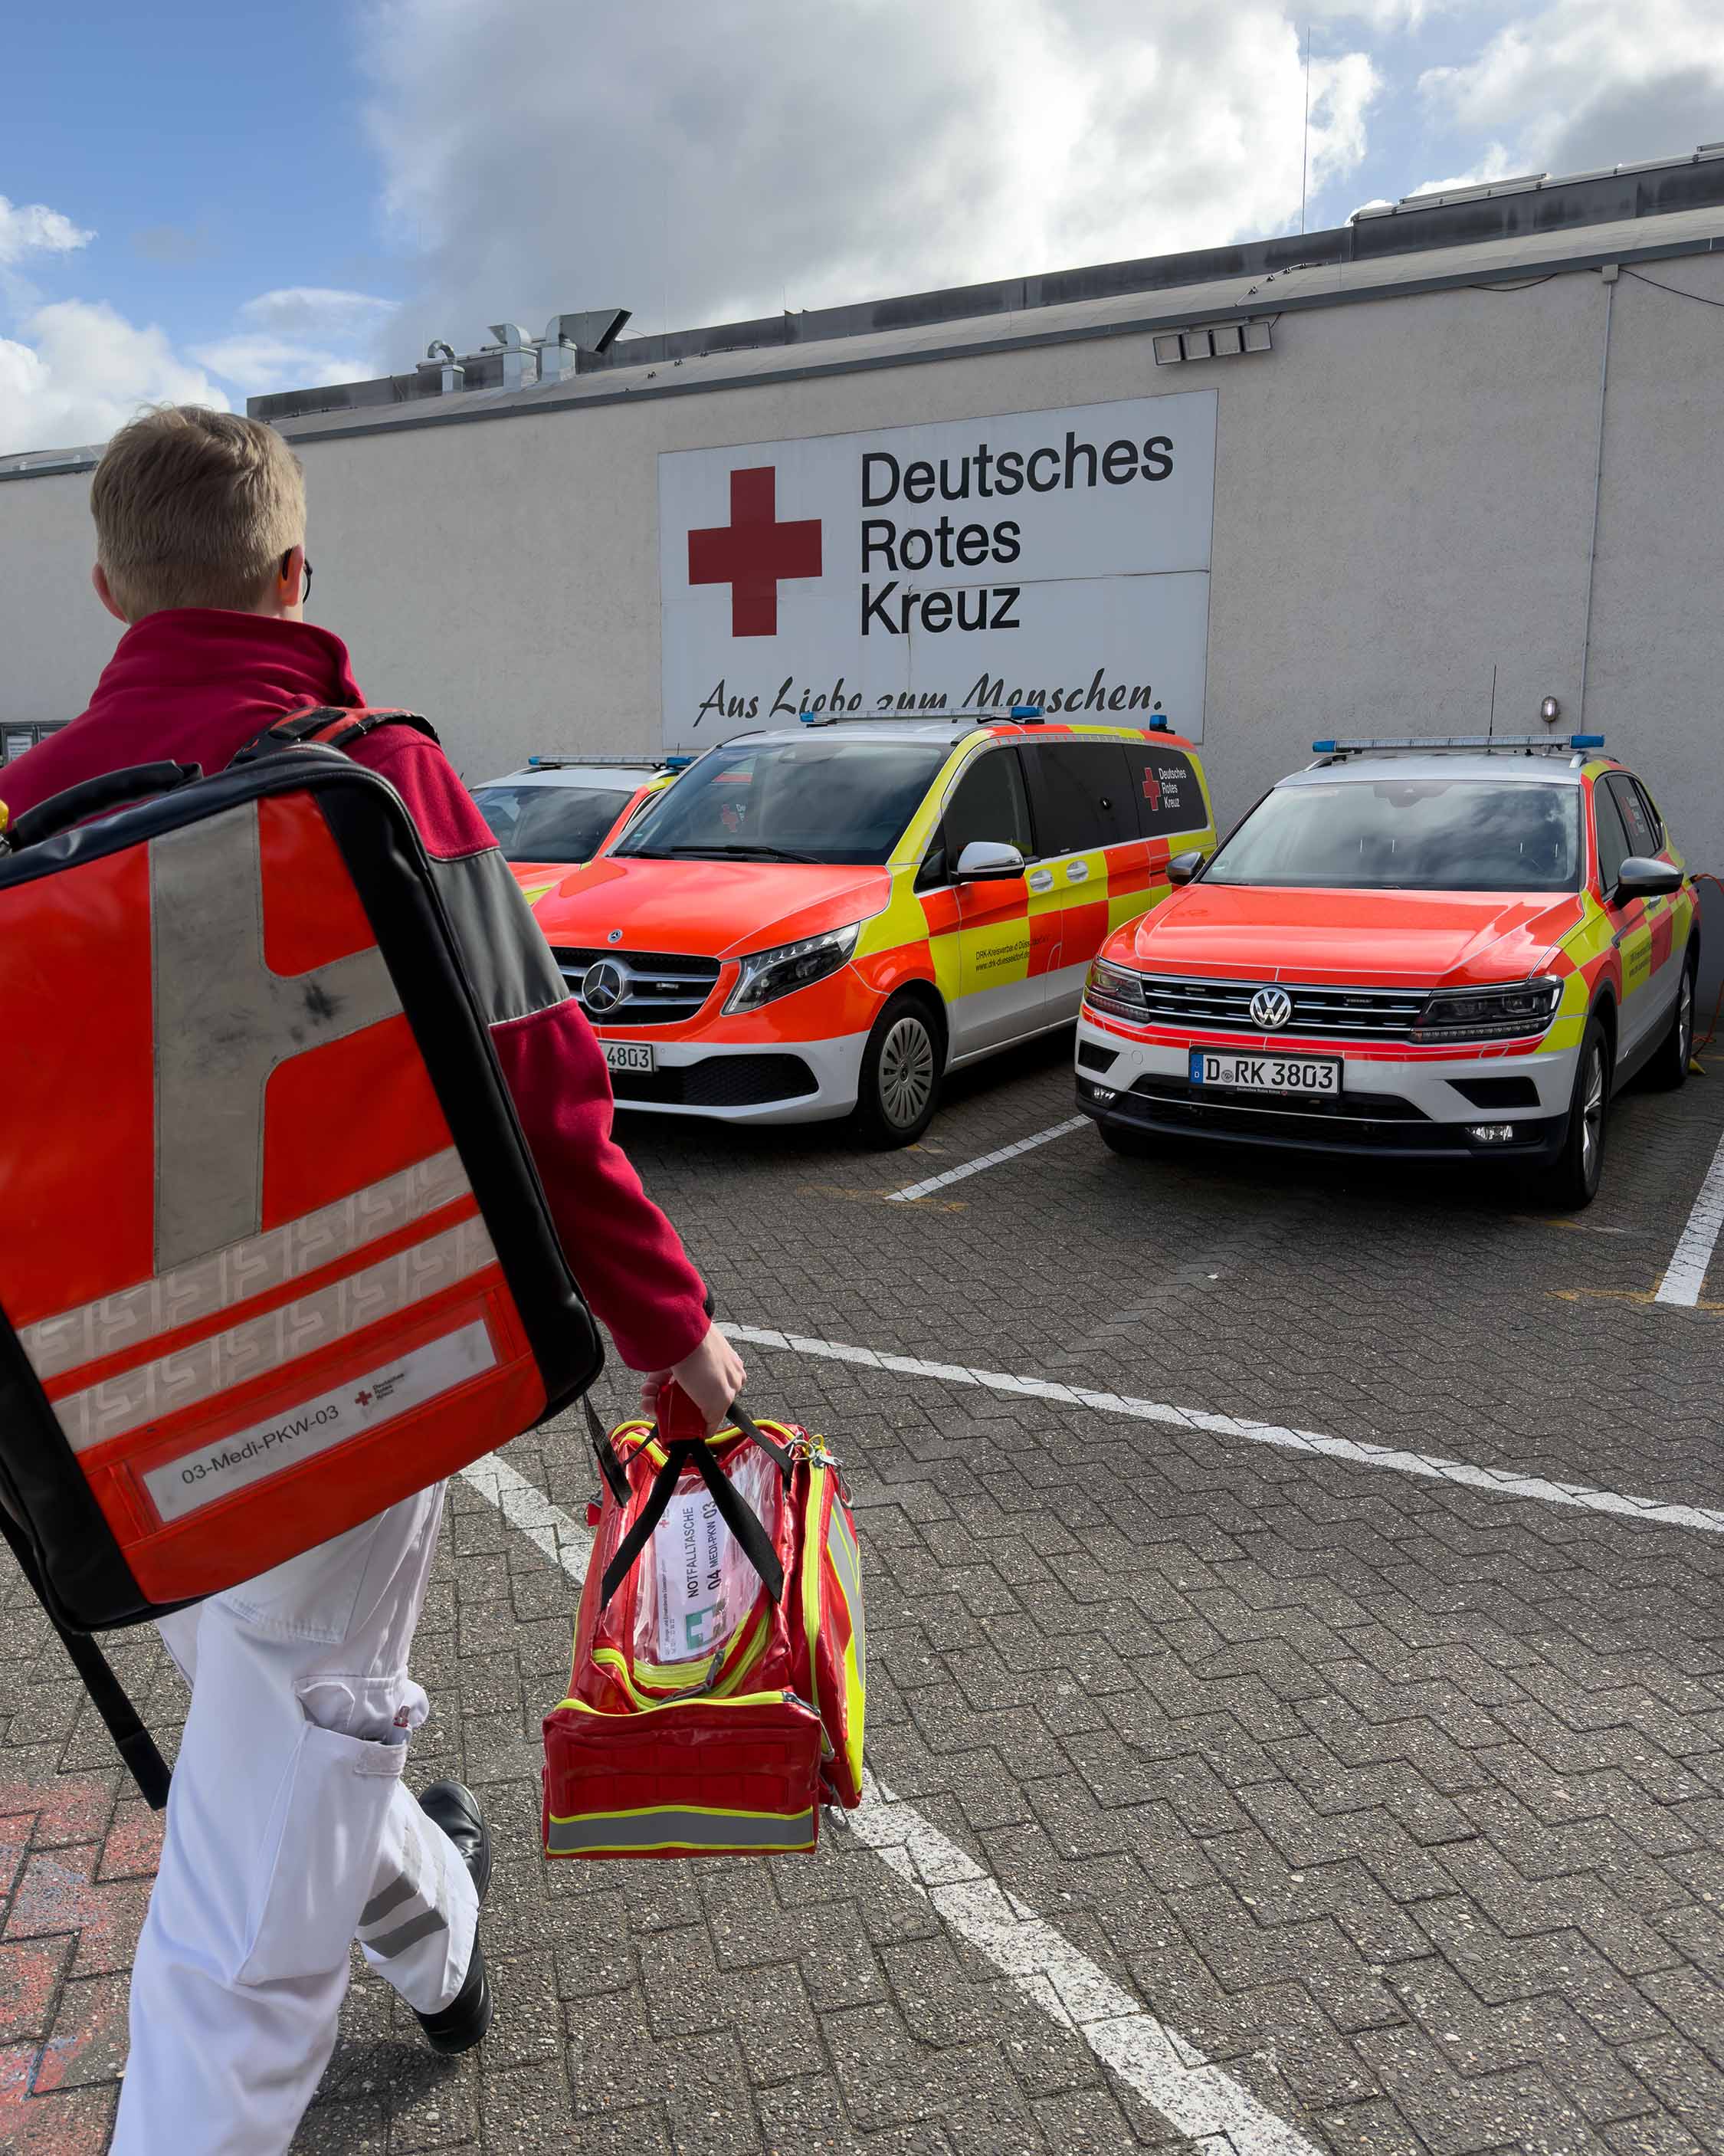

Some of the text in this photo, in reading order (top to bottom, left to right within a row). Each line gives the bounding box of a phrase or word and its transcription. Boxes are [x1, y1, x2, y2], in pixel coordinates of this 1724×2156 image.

[861, 432, 1174, 508] Deutsches
[861, 515, 1021, 573] Rotes
[861, 581, 1021, 636] Kreuz
[693, 678, 759, 727] Aus
[961, 668, 1162, 712] Menschen.
[1158, 767, 1187, 779] Deutsches
[1161, 782, 1178, 794] Rotes
[1164, 796, 1181, 809] Kreuz
[607, 1047, 649, 1068] 4803
[1234, 1060, 1266, 1085] RK
[1271, 1062, 1333, 1089] 3803
[181, 1405, 339, 1485] 03-Medi-PKW-03
[683, 1507, 699, 1598] NOTFALLTASCHE
[702, 1501, 722, 1590] 04 MEDI-PKW 03
